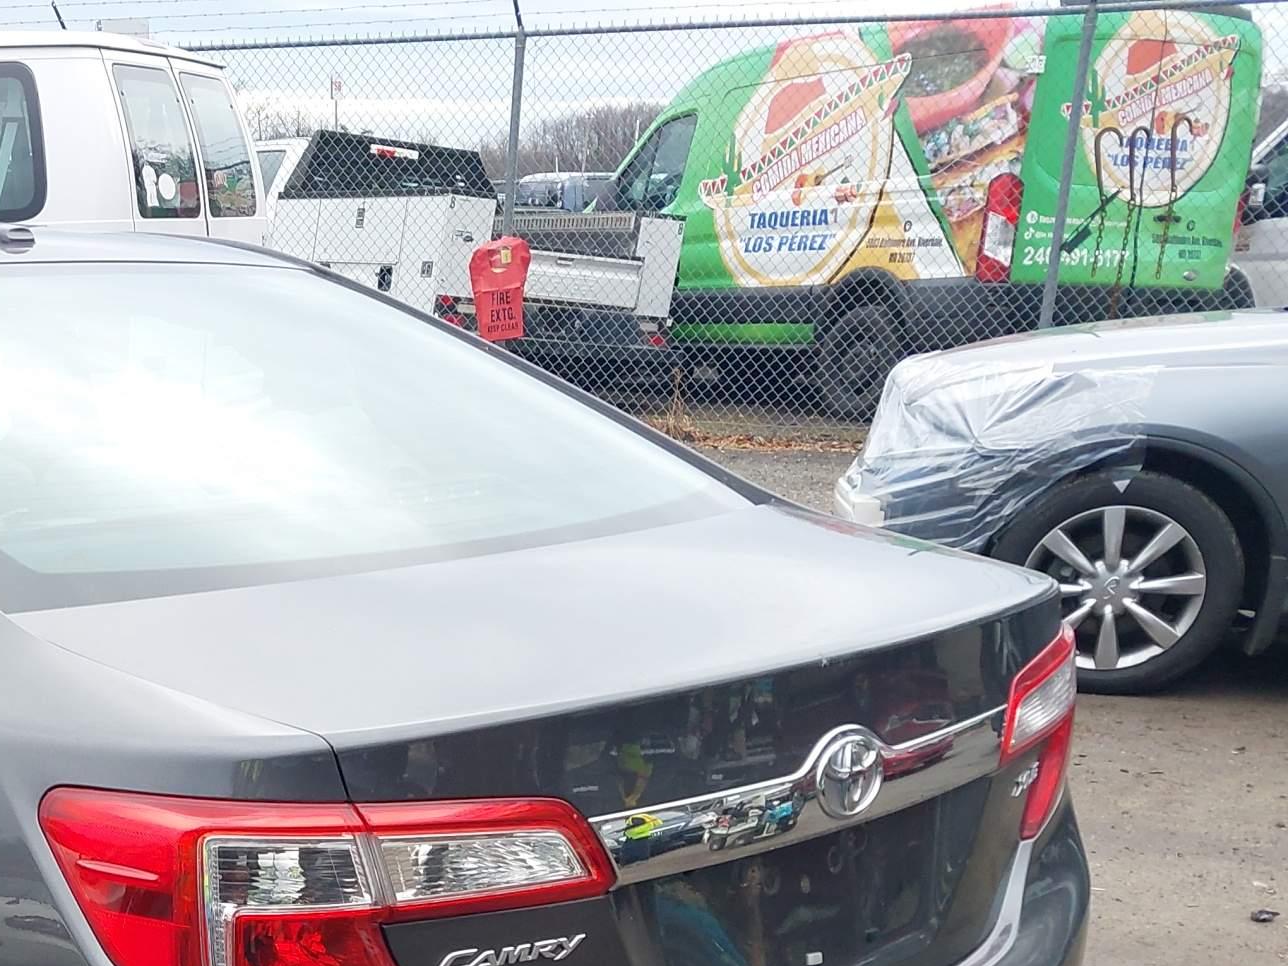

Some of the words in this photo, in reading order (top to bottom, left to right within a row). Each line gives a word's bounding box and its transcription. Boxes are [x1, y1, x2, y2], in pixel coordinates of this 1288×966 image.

[752, 149, 801, 201] COMIDA
[799, 105, 868, 166] MEXICANA
[748, 208, 830, 230] TAQUERIA
[491, 290, 511, 306] FIRE
